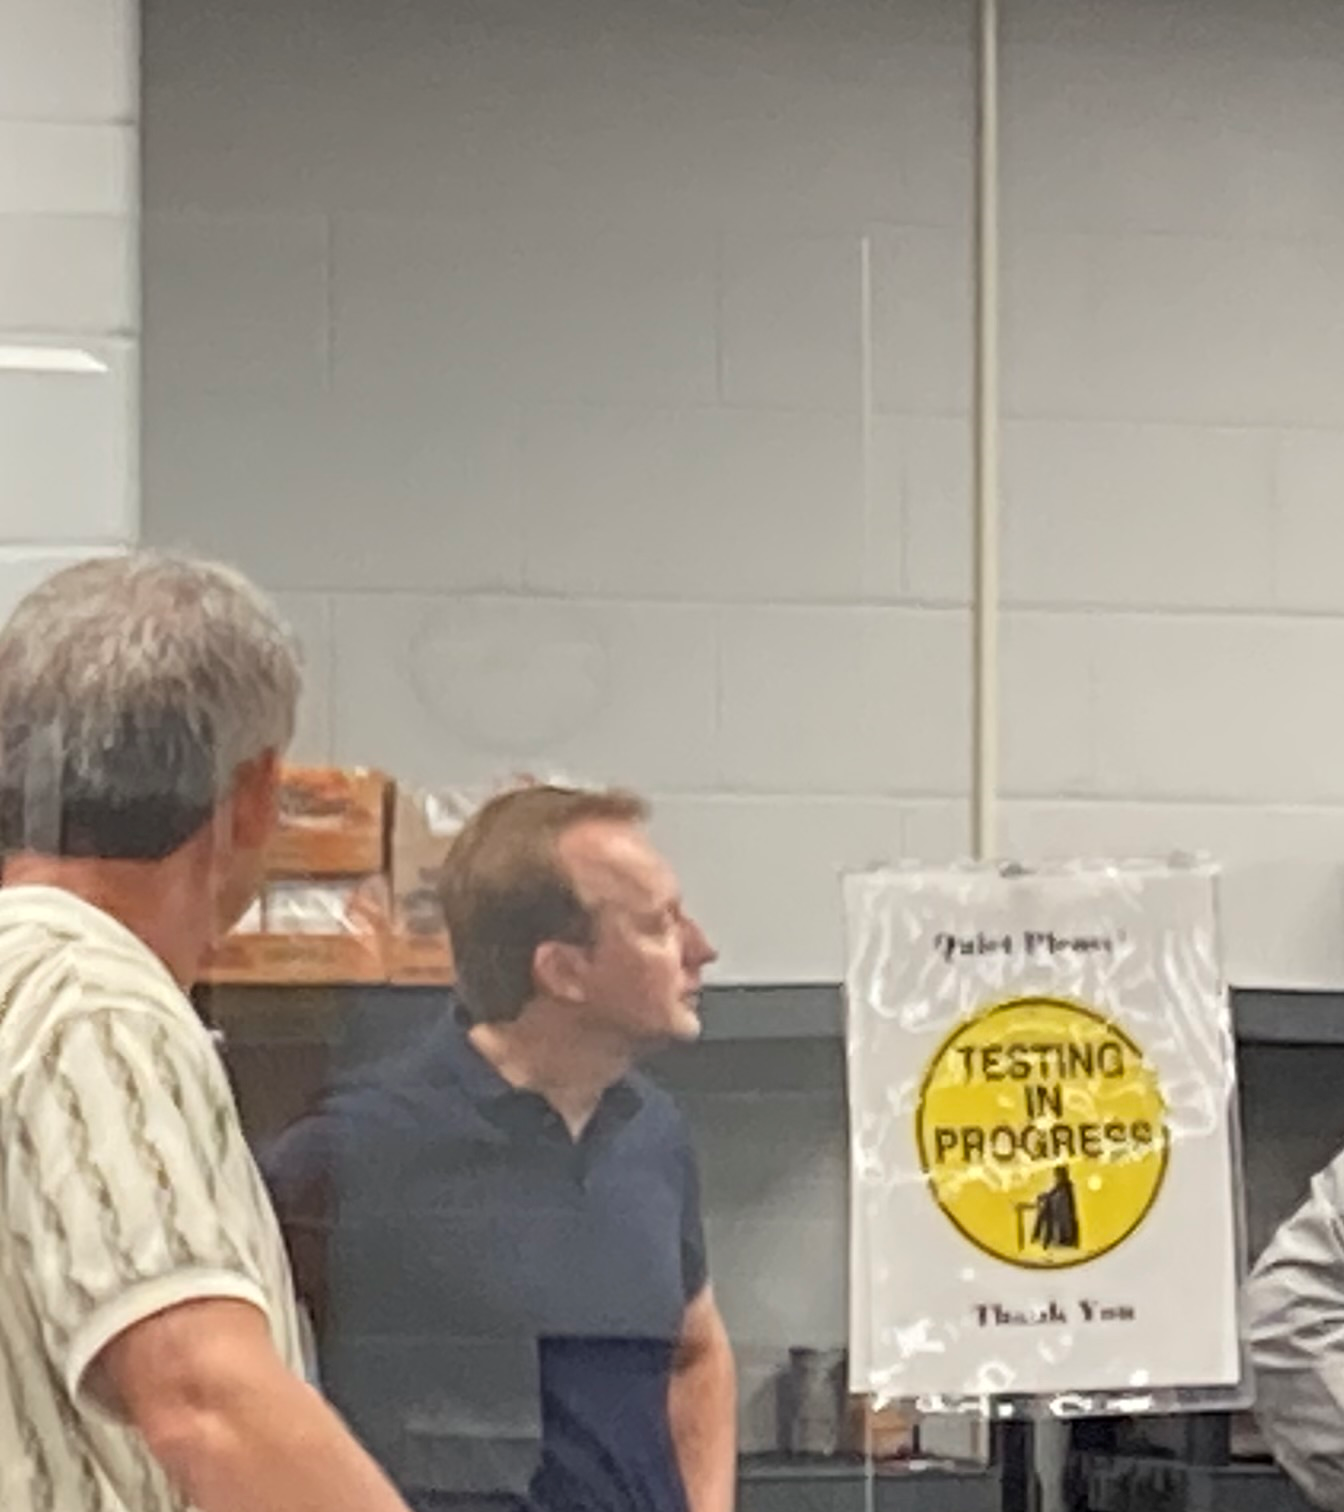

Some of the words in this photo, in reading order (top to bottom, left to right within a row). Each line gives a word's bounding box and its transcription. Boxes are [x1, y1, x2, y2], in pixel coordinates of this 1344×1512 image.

[955, 1041, 1125, 1084] TESTING
[1025, 1085, 1063, 1118] IN
[935, 1124, 1153, 1166] PROGRESS
[1079, 1300, 1134, 1322] You
